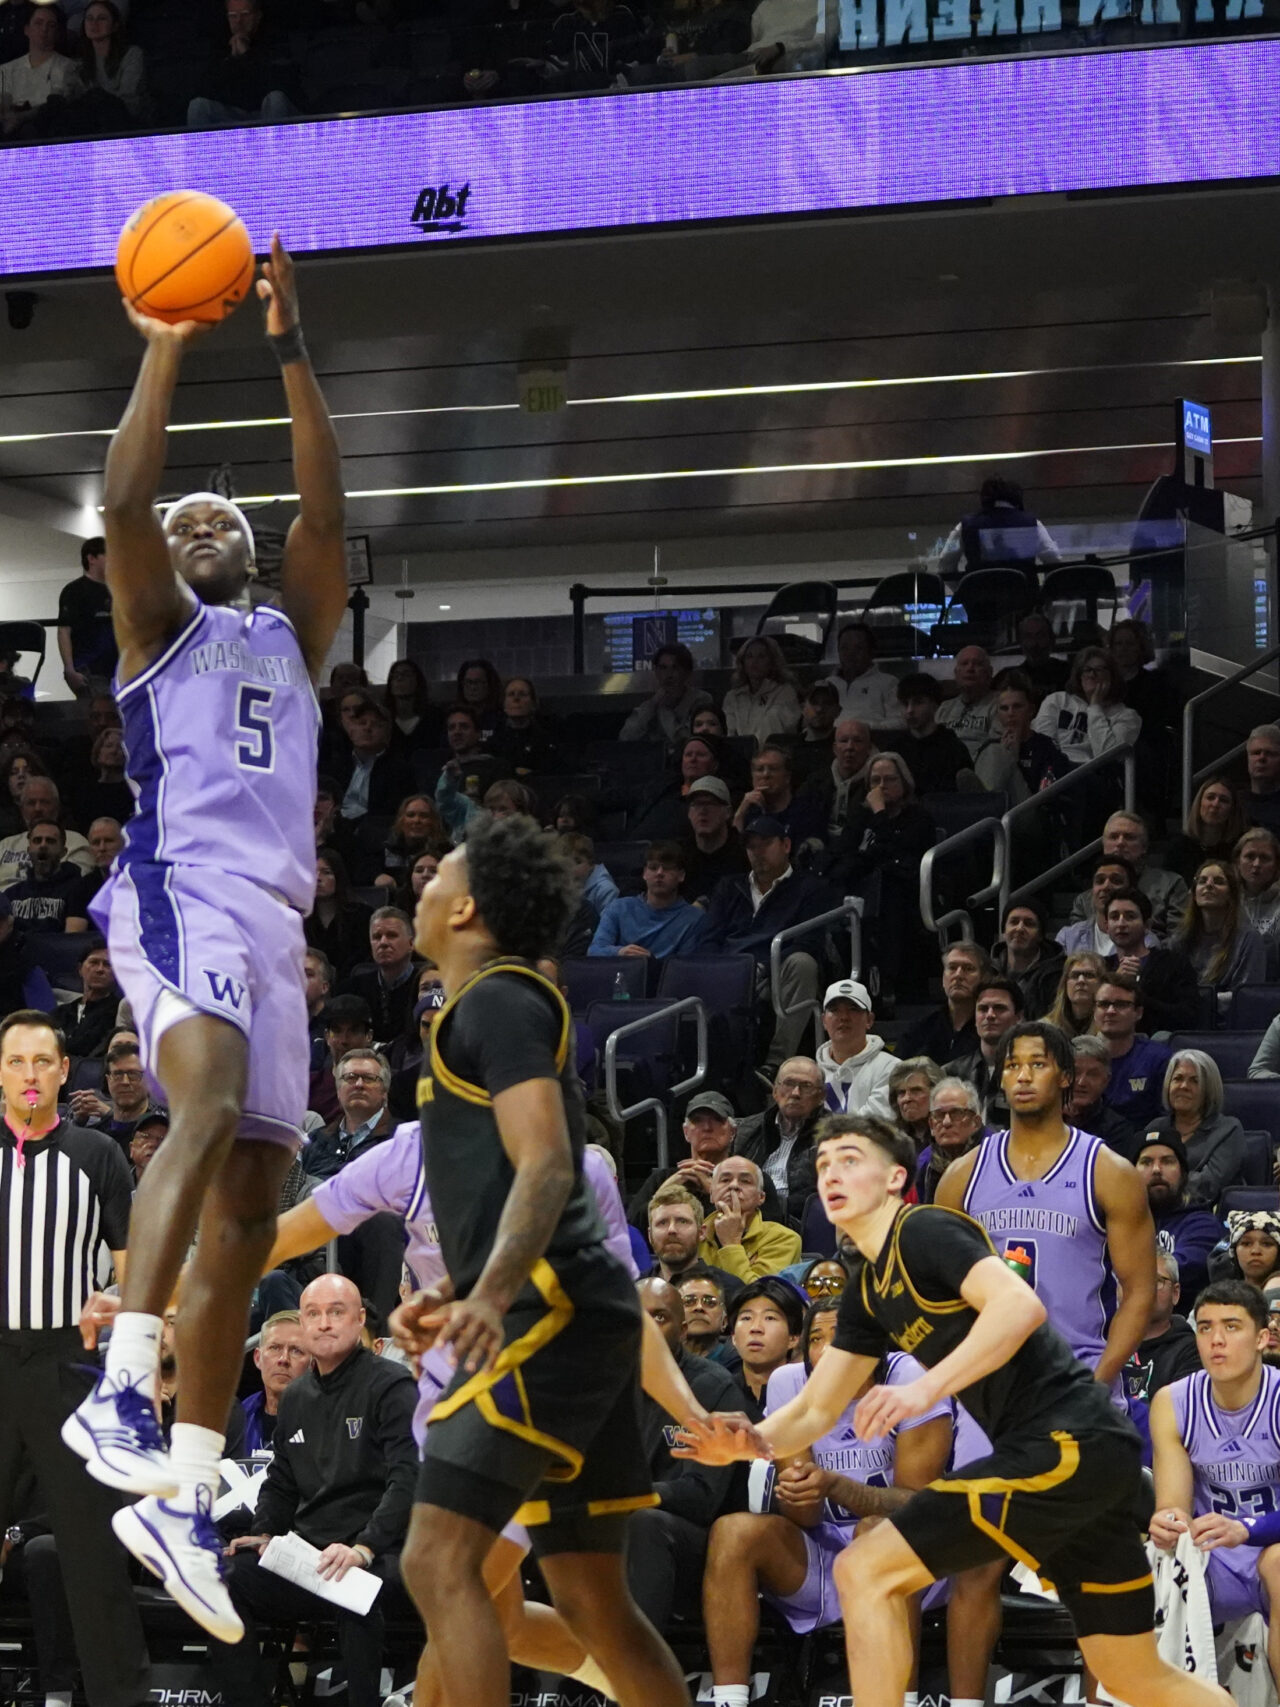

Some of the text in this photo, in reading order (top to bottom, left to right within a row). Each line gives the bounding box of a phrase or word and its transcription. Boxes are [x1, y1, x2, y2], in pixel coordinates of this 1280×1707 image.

[411, 183, 471, 222] Abt
[527, 385, 560, 413] EXIT
[1185, 410, 1209, 433] ATM
[234, 680, 277, 775] 5
[200, 967, 248, 1010] W
[431, 994, 444, 1008] N
[1128, 1077, 1147, 1092] W
[816, 1448, 893, 1472] ASHINTON
[1207, 1482, 1279, 1517] 23
